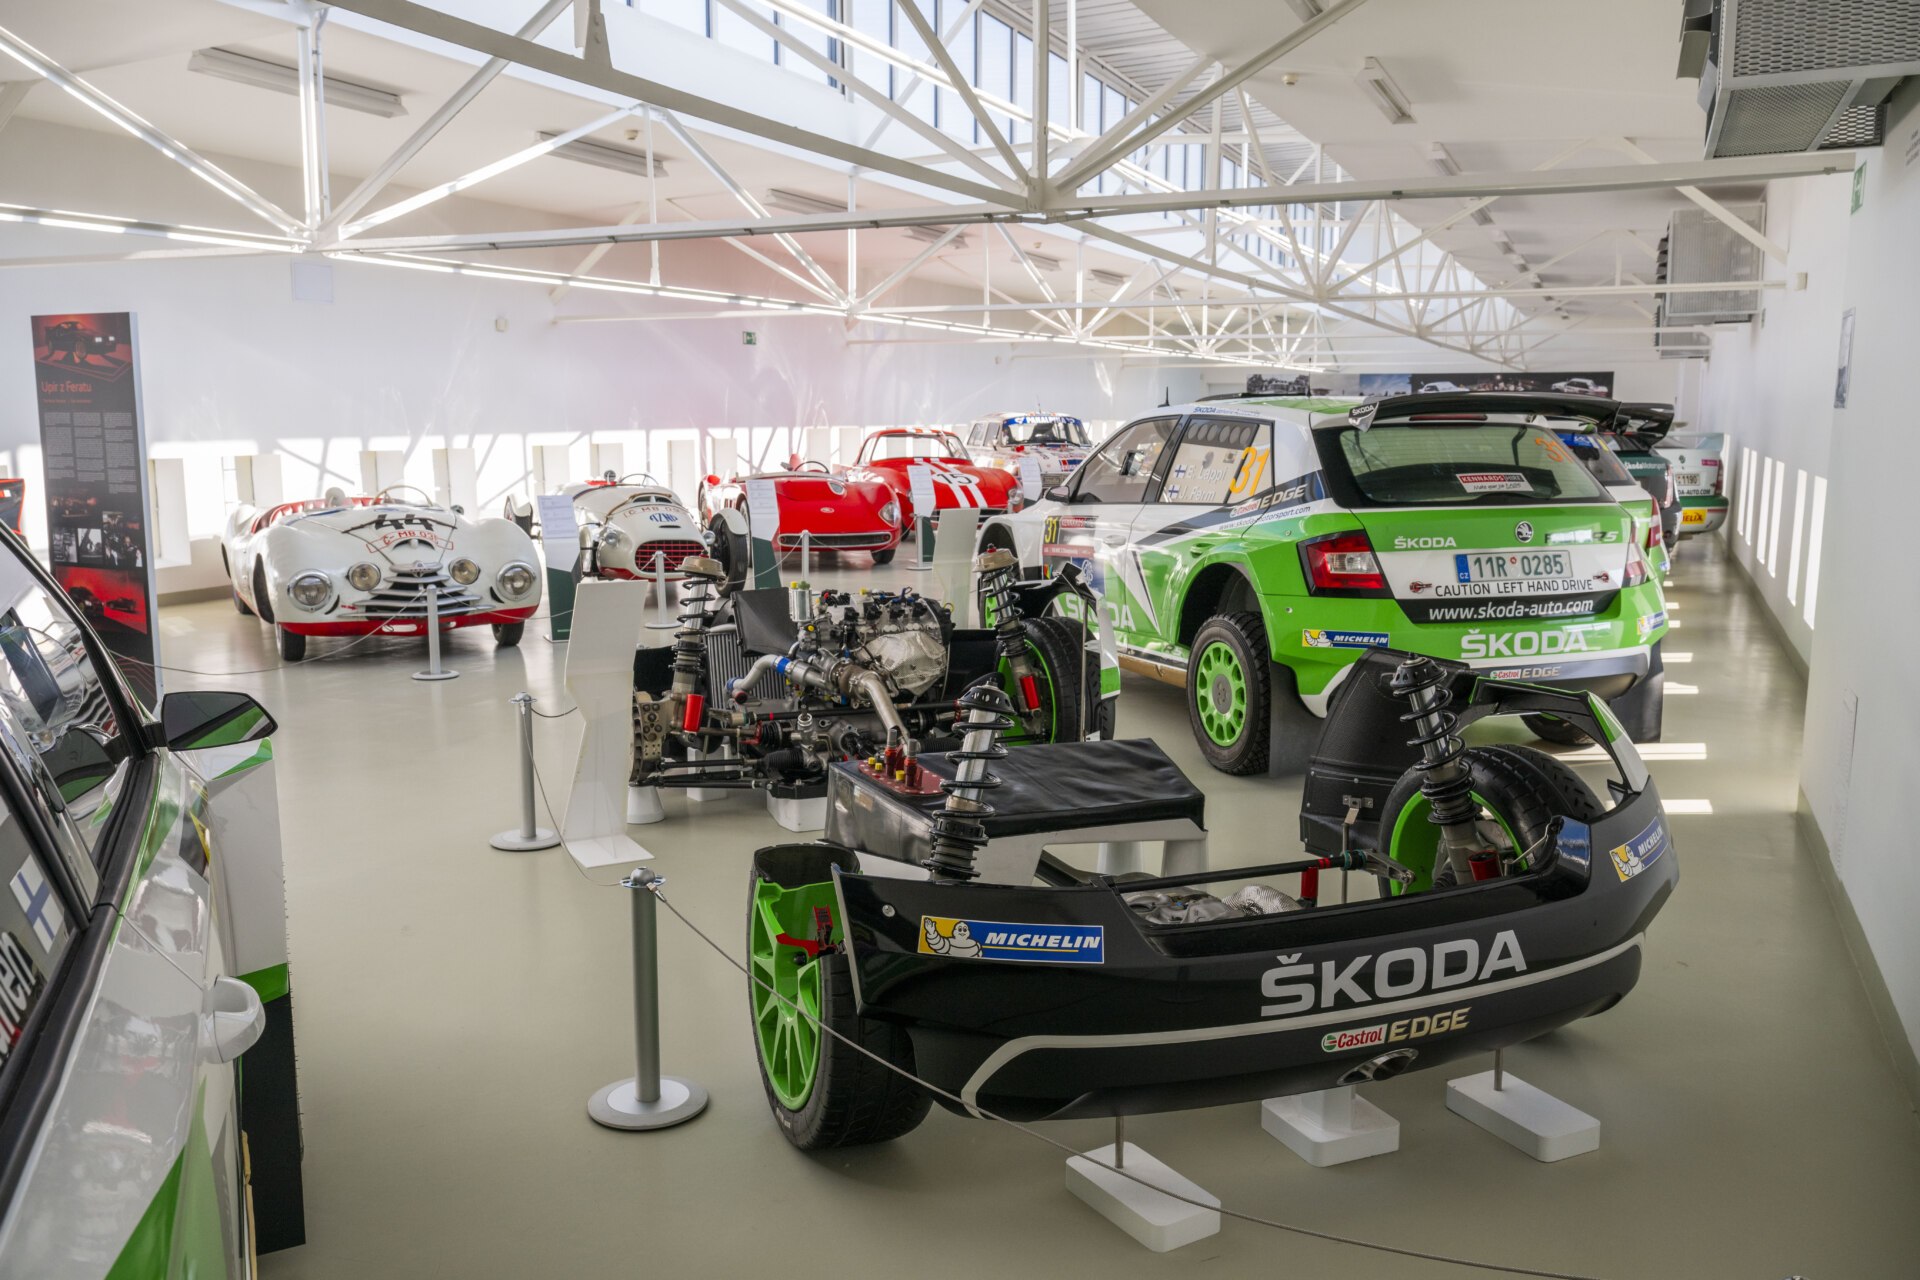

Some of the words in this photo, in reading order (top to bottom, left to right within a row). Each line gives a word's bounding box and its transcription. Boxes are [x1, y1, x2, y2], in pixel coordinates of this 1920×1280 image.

[1535, 437, 1573, 463] 31
[936, 473, 972, 484] 15
[1198, 464, 1229, 486] Lappi
[1230, 446, 1270, 496] 31
[1460, 474, 1505, 483] KENNARDS
[1259, 483, 1308, 510] EDGE
[374, 514, 434, 531] 44
[1045, 516, 1058, 544] 31
[398, 530, 417, 538] MB
[1394, 535, 1457, 549] ŠKODA
[1459, 572, 1469, 580] CZ
[1474, 556, 1508, 578] 11R
[1521, 554, 1564, 577] 0285
[1435, 582, 1491, 597] CAUTION
[1497, 582, 1523, 594] LEFT
[1527, 580, 1559, 593] HAND
[1562, 579, 1593, 591] DRIVE
[1428, 599, 1594, 621] www.skoda-auto.com
[1333, 634, 1389, 644] MICHELIN
[1461, 628, 1589, 659] ŠKODA
[1497, 669, 1520, 679] Castrol
[1521, 666, 1562, 679] EDGE
[1637, 824, 1664, 857] MICHELIN
[985, 931, 1101, 949] MICHELIN
[1260, 929, 1528, 1017] ŠKODA
[1336, 1027, 1384, 1049] Castrol
[1387, 1006, 1473, 1044] EDGE
